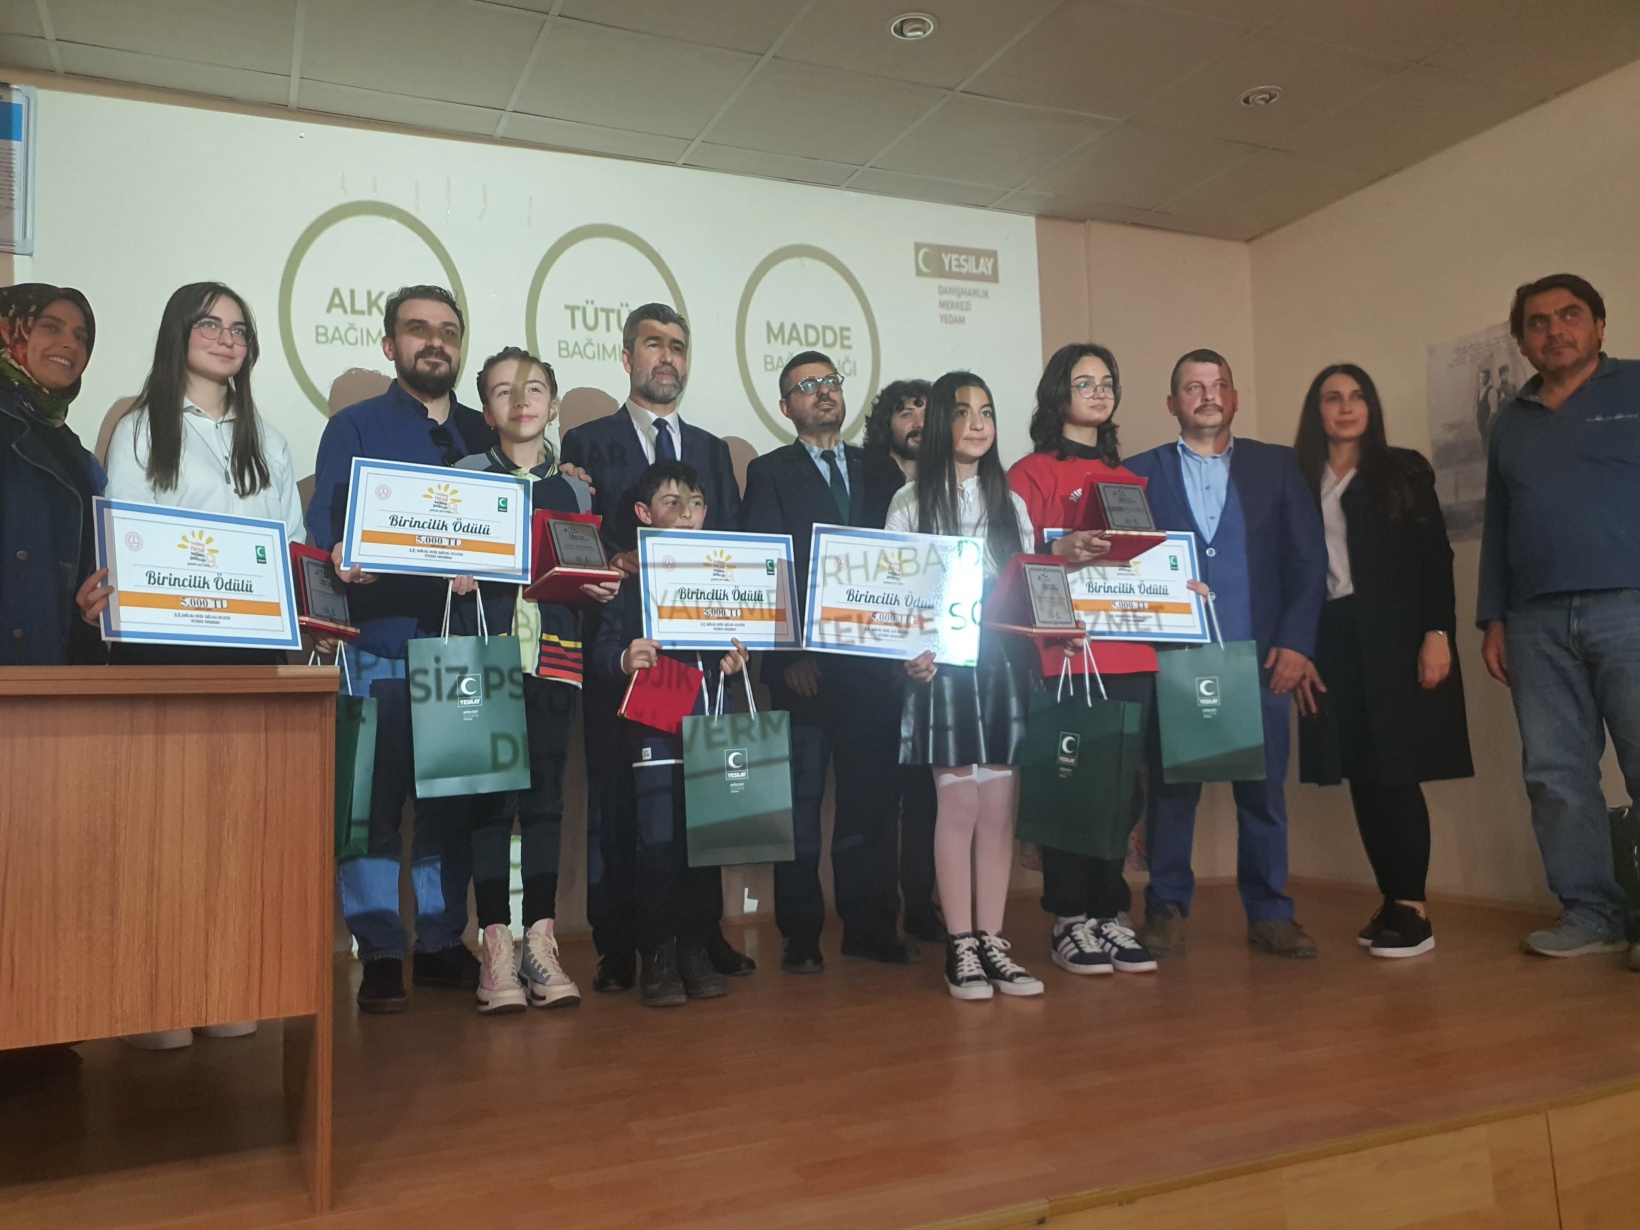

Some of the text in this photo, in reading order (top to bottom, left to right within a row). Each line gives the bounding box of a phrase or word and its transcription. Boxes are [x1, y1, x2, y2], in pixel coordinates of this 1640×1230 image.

[766, 320, 852, 350] MADDE
[389, 515, 491, 536] Birincilik Ödülü
[145, 570, 254, 593] Birincilik Ödülü
[1085, 579, 1169, 595] Birincilik Ödülü
[678, 585, 764, 602] Birincilik Ödülü
[846, 588, 900, 607] Birincilik
